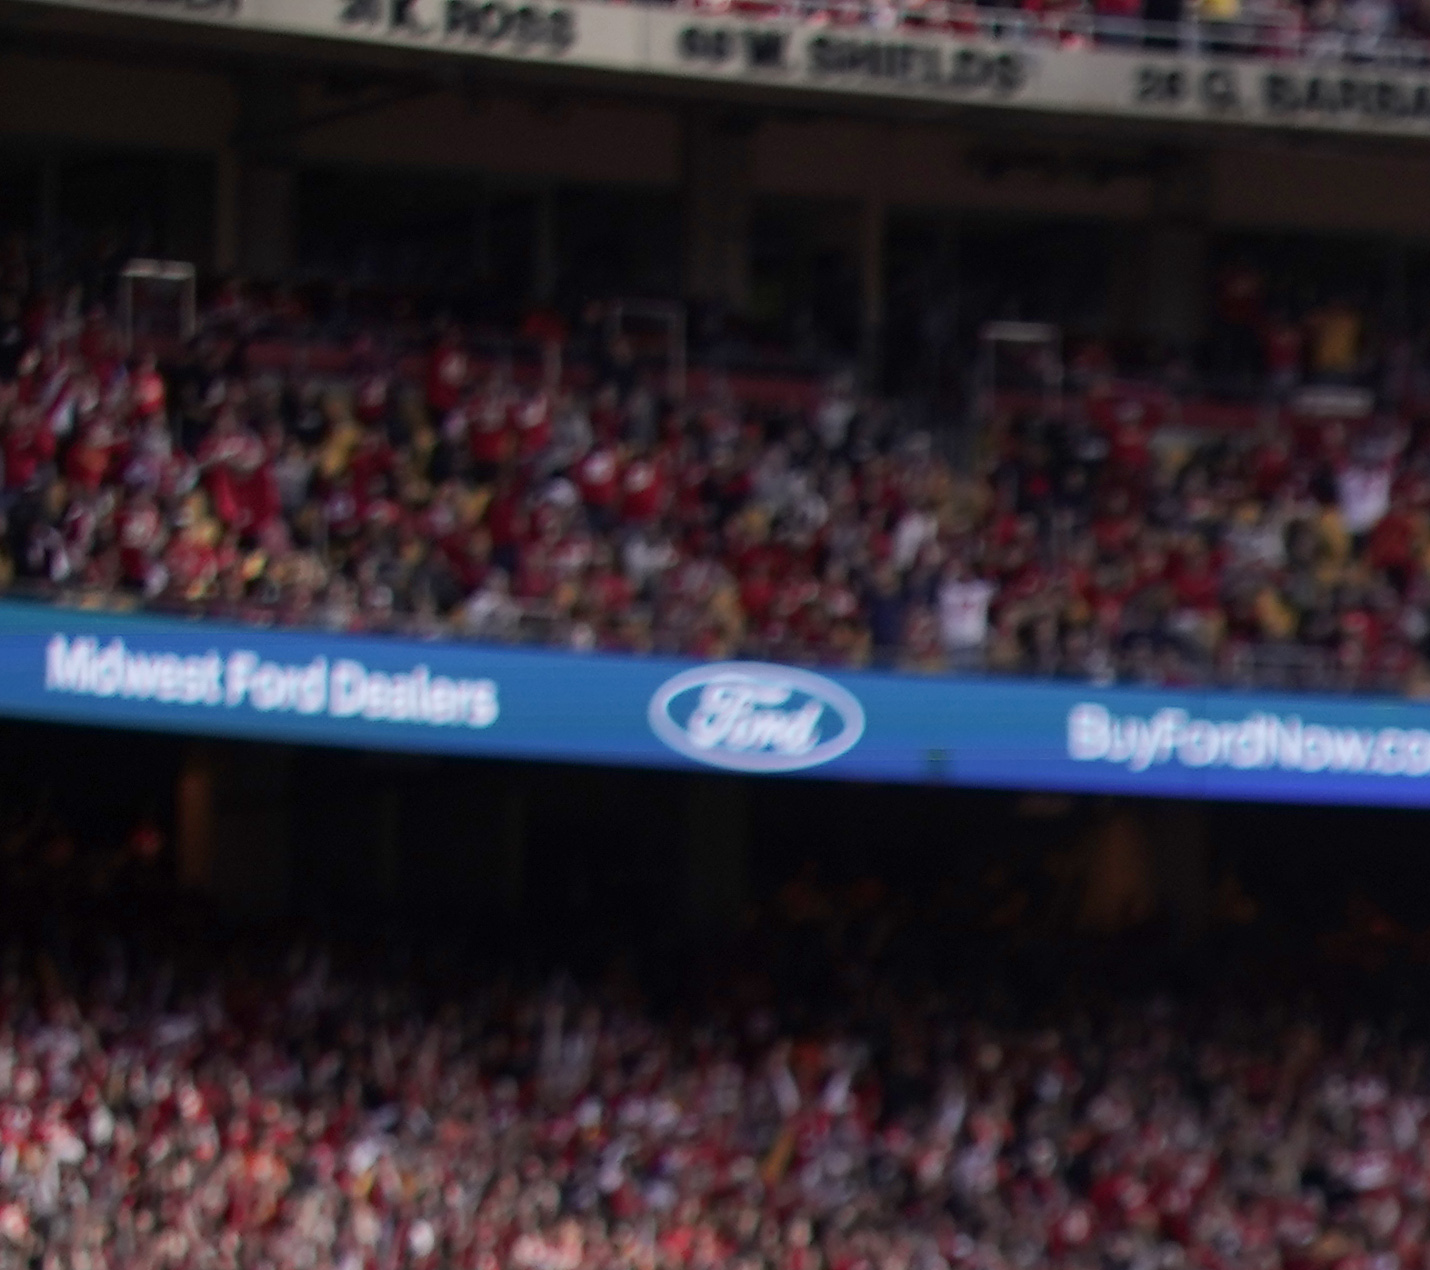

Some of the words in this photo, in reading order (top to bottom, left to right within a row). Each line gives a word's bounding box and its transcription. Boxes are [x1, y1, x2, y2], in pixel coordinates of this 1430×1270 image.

[441, 0, 578, 53] ROSS
[805, 35, 1027, 92] SHIELDS
[45, 633, 224, 706] Midwest
[225, 648, 328, 716] Ford
[329, 658, 500, 728] Dealers
[687, 674, 826, 754] Ford
